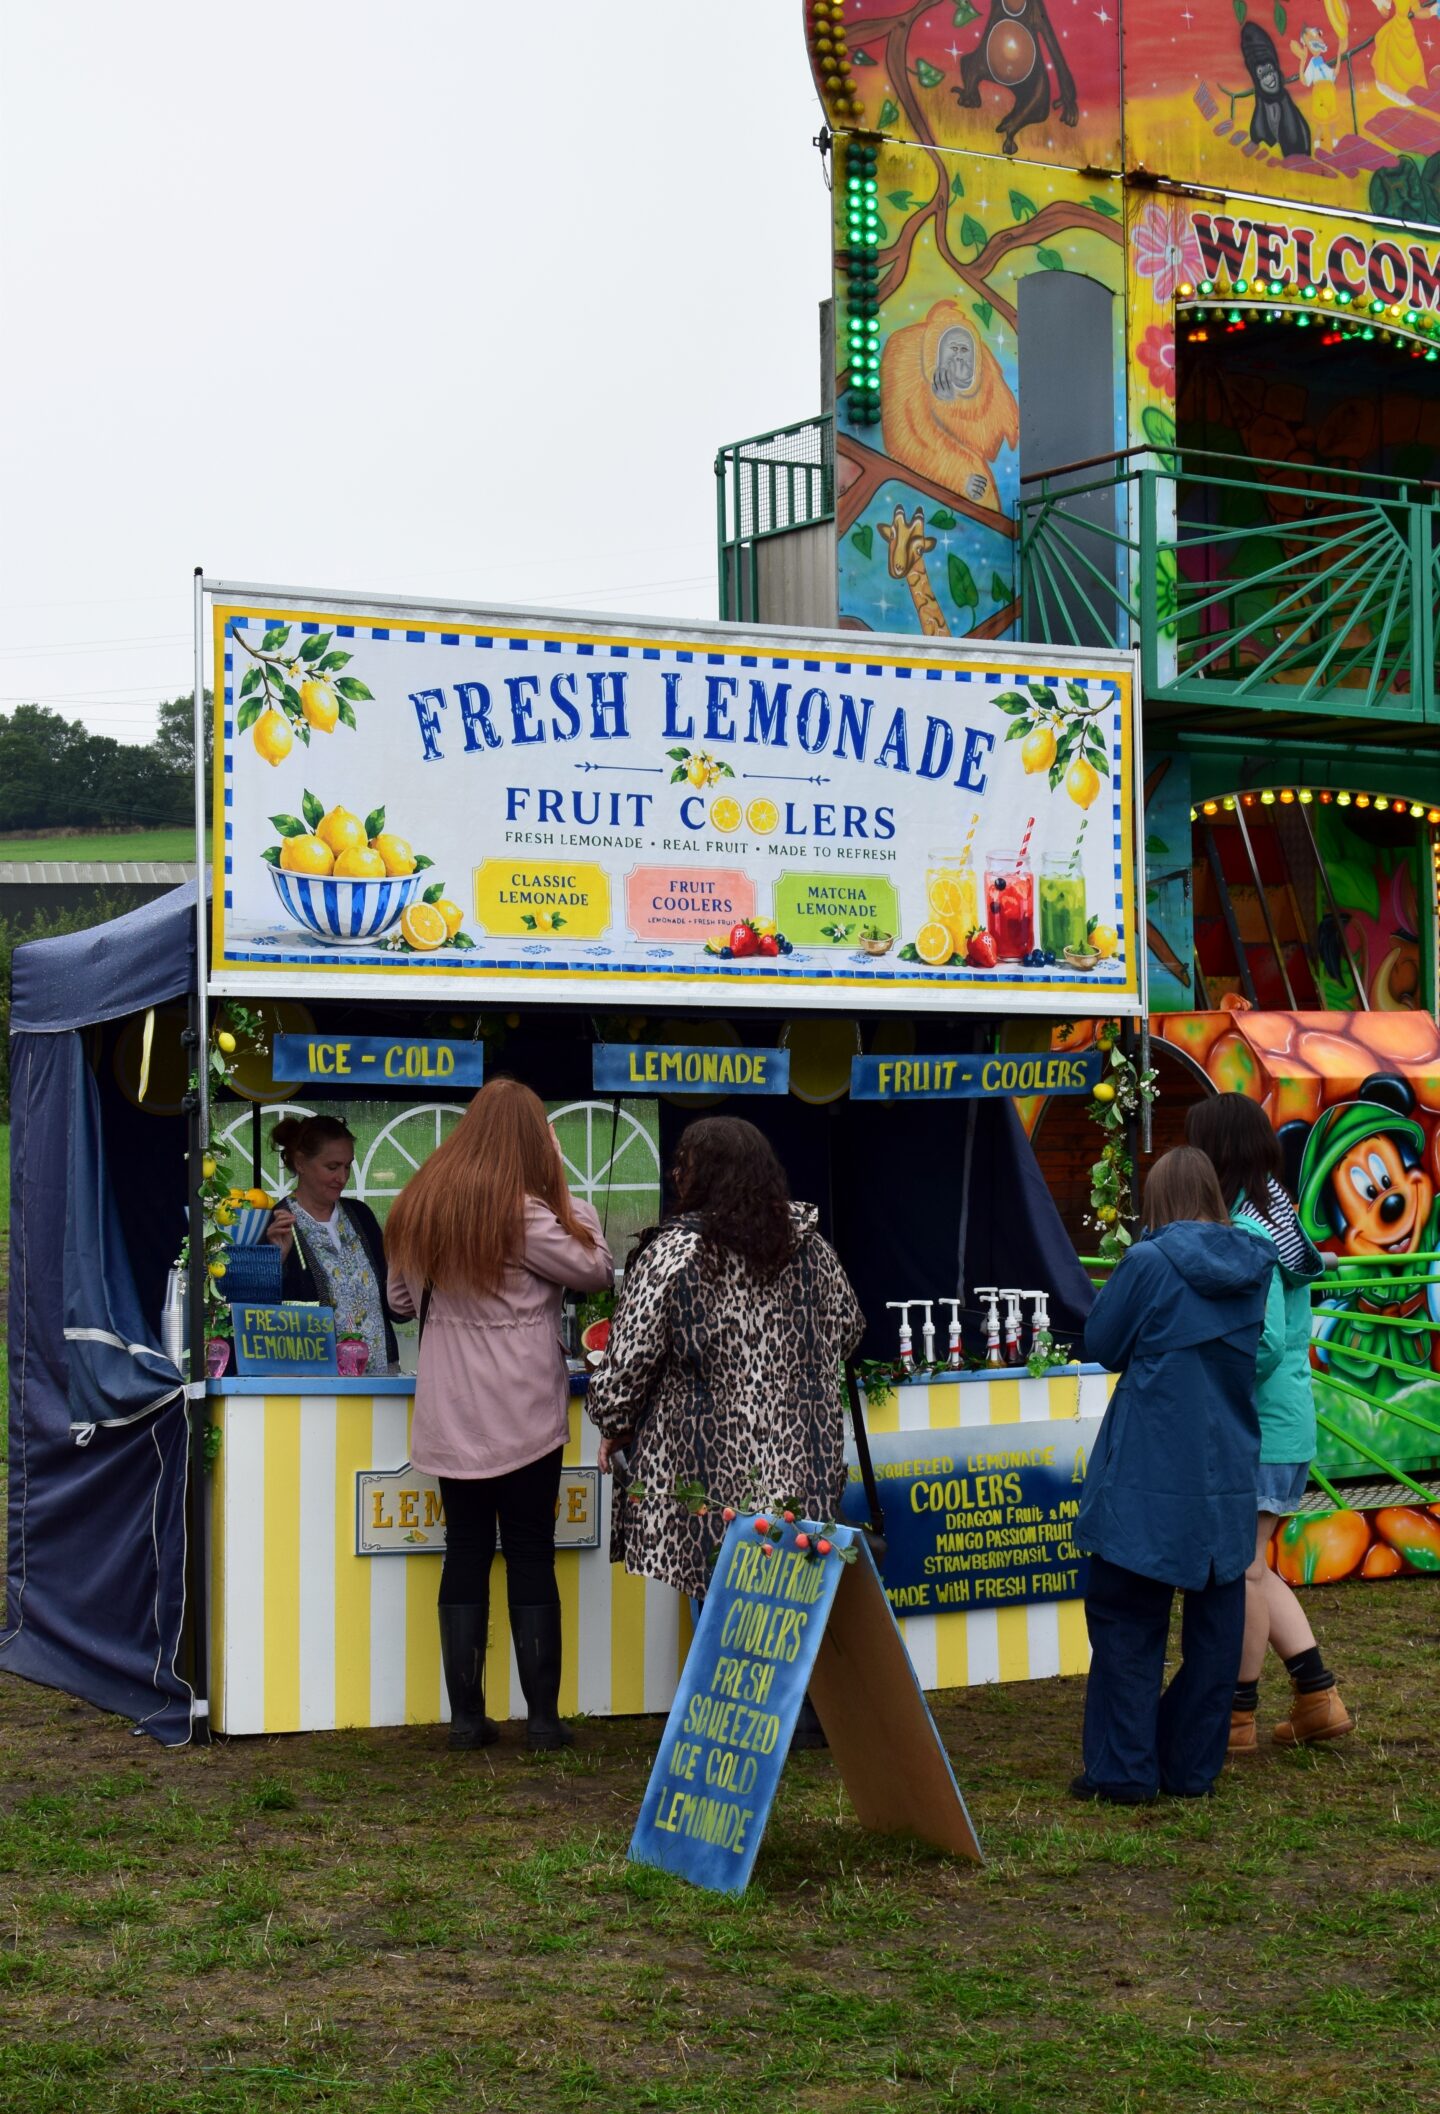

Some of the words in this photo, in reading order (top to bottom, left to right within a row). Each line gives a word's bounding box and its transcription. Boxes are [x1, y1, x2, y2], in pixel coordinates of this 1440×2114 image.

[408, 671, 629, 762] FRESH
[660, 672, 996, 795] LEMONADE
[506, 787, 653, 827] FRUIT
[680, 795, 896, 839] COOLERS
[505, 831, 553, 844] FRESH
[560, 834, 643, 849] LEMONADE
[663, 839, 700, 852] REAL
[706, 841, 749, 854] FRUIT
[768, 845, 807, 857] MADE
[813, 846, 831, 858] TO
[837, 848, 897, 861] REFRESH
[511, 873, 577, 888] CLASSIC
[669, 880, 715, 894] FRUIT
[808, 886, 867, 901] MATCHA
[499, 891, 589, 906] LEMONADE
[652, 896, 732, 913] COOLERS
[796, 903, 878, 918] LEMONADE
[647, 917, 686, 925] LEMONADE
[694, 918, 715, 926] FRESH
[308, 1042, 352, 1074] ICE
[384, 1045, 455, 1079] COLD
[629, 1051, 767, 1085] LEMONADE
[981, 1060, 1088, 1091] COOLERS
[244, 1308, 301, 1333] FRESH
[242, 1333, 329, 1361] LEMONADE
[874, 1456, 954, 1482] SQUEEZED
[967, 1446, 1056, 1473] LEMONADE
[910, 1472, 1023, 1513] COOLERS
[945, 1508, 1002, 1531] DRAGON
[936, 1529, 983, 1554] MANGO
[725, 1540, 784, 1596] FRESH
[885, 1583, 930, 1608] MADE
[974, 1575, 1026, 1600] FRESH
[720, 1598, 808, 1663] COOLERS
[710, 1656, 776, 1704] FRESH
[683, 1693, 780, 1755] SQUEEZED
[669, 1740, 702, 1781] ICE
[705, 1747, 758, 1795] COLD
[654, 1785, 754, 1855] LEMONADE
